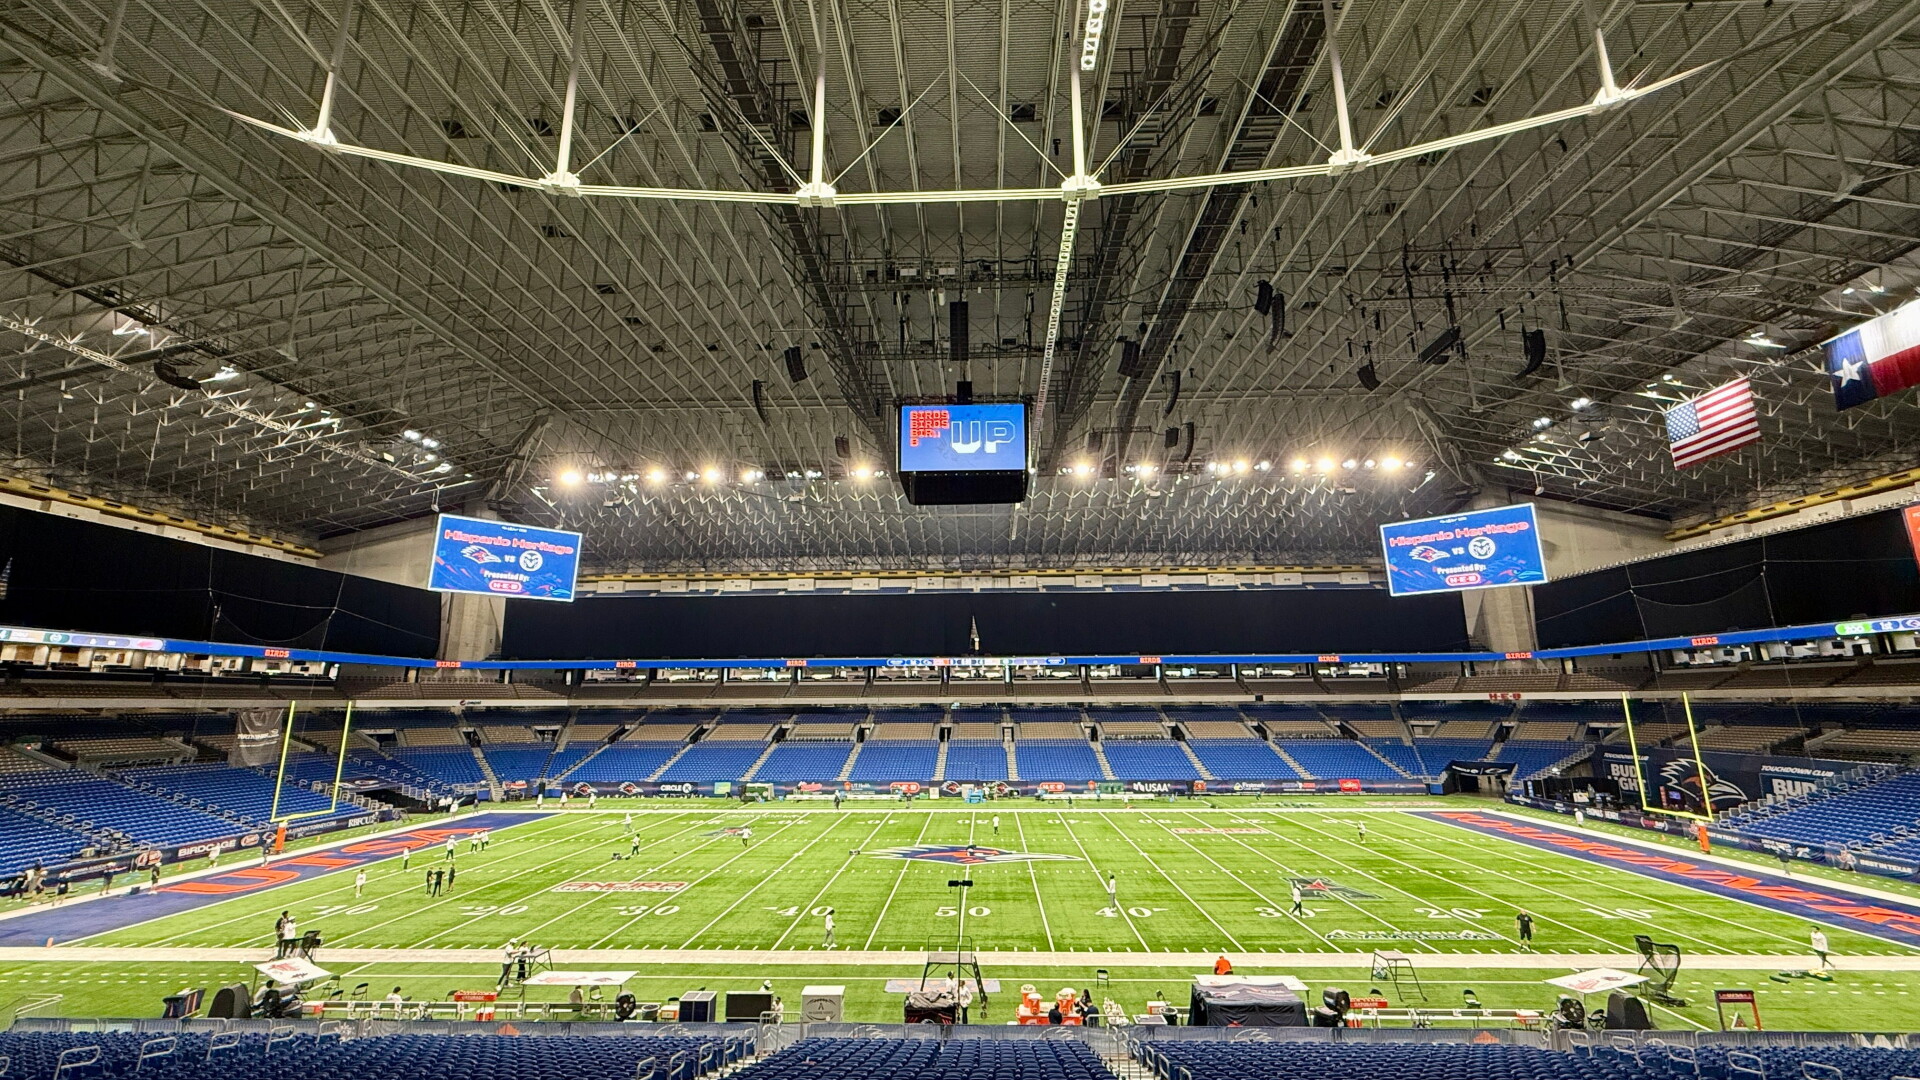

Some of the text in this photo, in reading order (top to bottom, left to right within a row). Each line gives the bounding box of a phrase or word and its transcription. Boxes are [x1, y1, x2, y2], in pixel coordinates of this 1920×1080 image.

[910, 410, 949, 420] BIRDS
[910, 419, 949, 429] BIRDS
[951, 420, 1015, 454] UP
[1389, 521, 1530, 547] Hispanic Heritage
[444, 529, 512, 547] Hispanic
[512, 538, 574, 555] Heritage
[483, 569, 520, 581] Presented
[1437, 564, 1477, 575] Presented
[1449, 575, 1478, 584] H-E-B
[1692, 637, 1718, 646] BIRDS
[265, 649, 290, 658] BIRDS
[1610, 763, 1637, 778] BUD
[1761, 765, 1835, 778] TOUCHDOWN CLUB
[1145, 783, 1169, 792] USAA
[1772, 778, 1817, 796] BUD
[311, 905, 379, 916] 10
[461, 905, 529, 917] 20
[619, 905, 681, 916] 30
[776, 906, 834, 917] 40
[935, 906, 992, 918] 50
[1095, 906, 1152, 918] 40
[1254, 906, 1316, 918] 30
[1414, 907, 1482, 919] 20
[1580, 907, 1653, 919] 10
